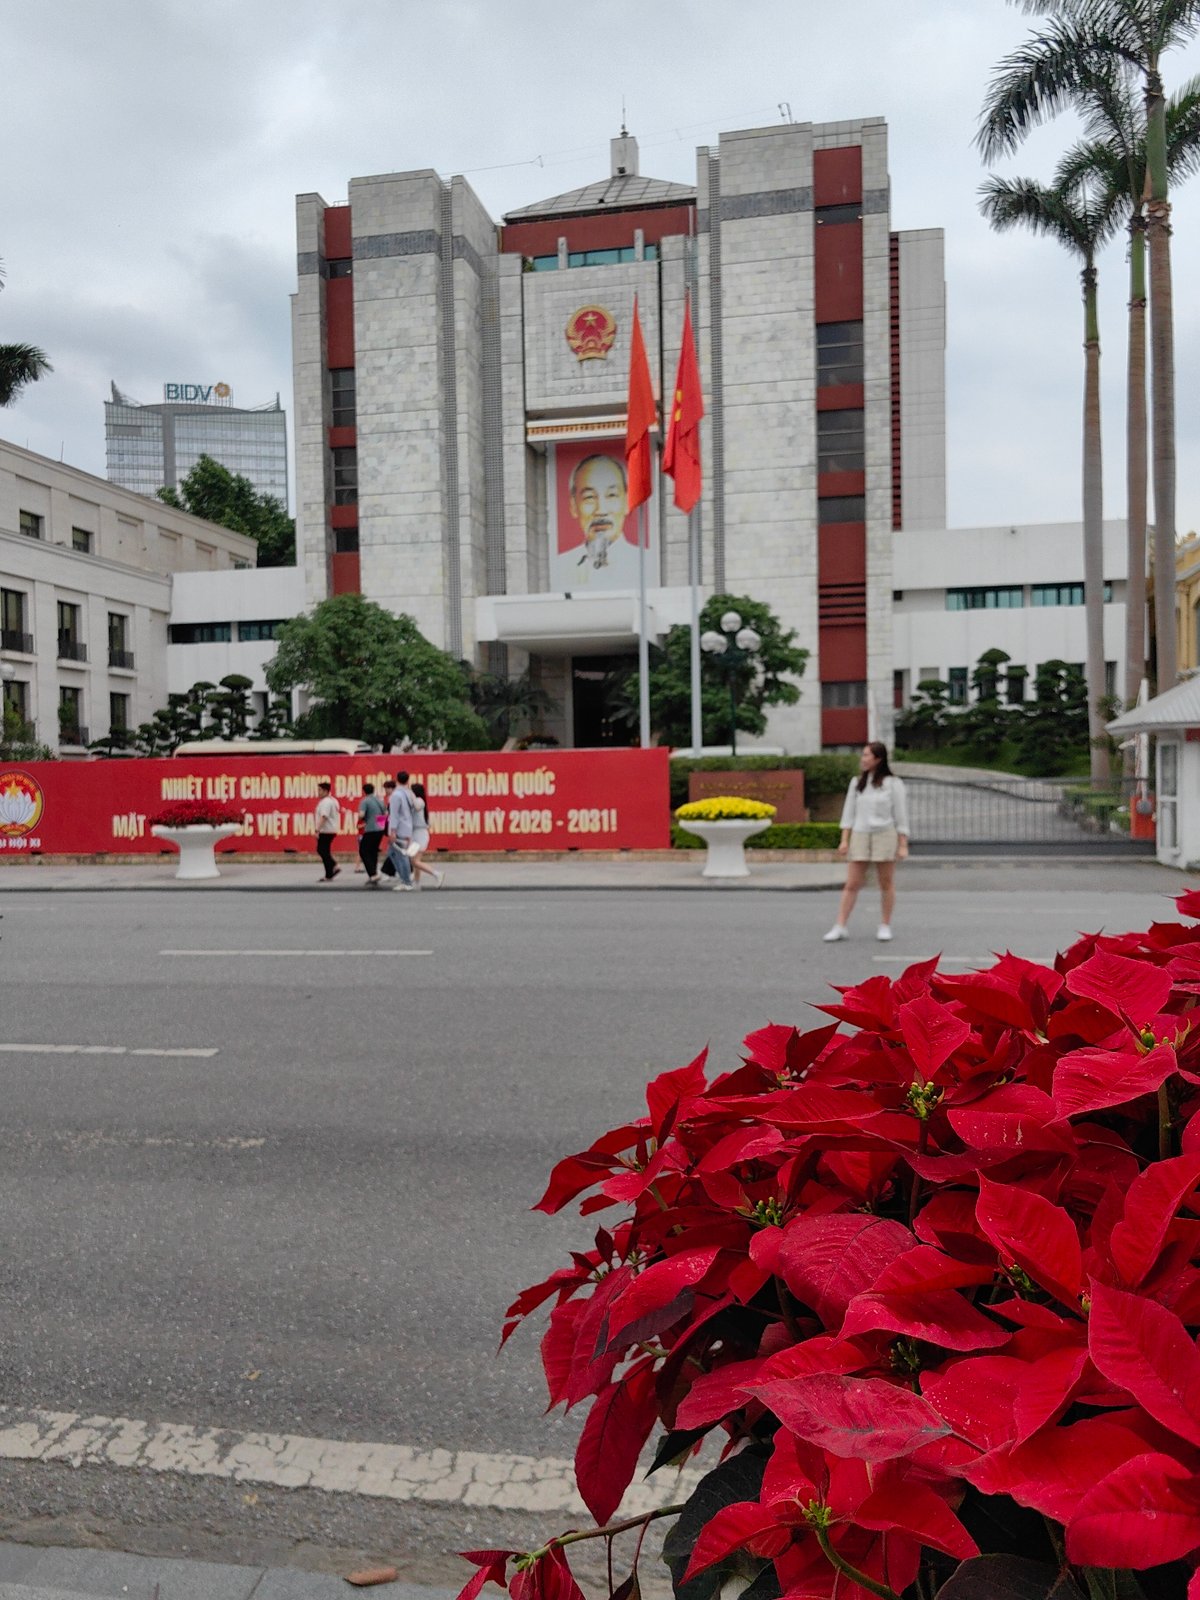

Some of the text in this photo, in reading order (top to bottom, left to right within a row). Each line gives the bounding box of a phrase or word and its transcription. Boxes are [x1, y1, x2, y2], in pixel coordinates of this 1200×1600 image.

[166, 383, 213, 401] BIDV
[206, 773, 237, 804] LIỆT
[240, 771, 281, 800] CHÀO
[465, 767, 510, 797] TOÀN
[512, 765, 556, 799] QUỐC
[112, 811, 147, 841] MẶT
[256, 809, 290, 840] VIỆT
[428, 807, 481, 838] NHIỆM
[484, 806, 506, 834] KỲ
[508, 809, 553, 834] 2026
[567, 808, 618, 833] 2031!
